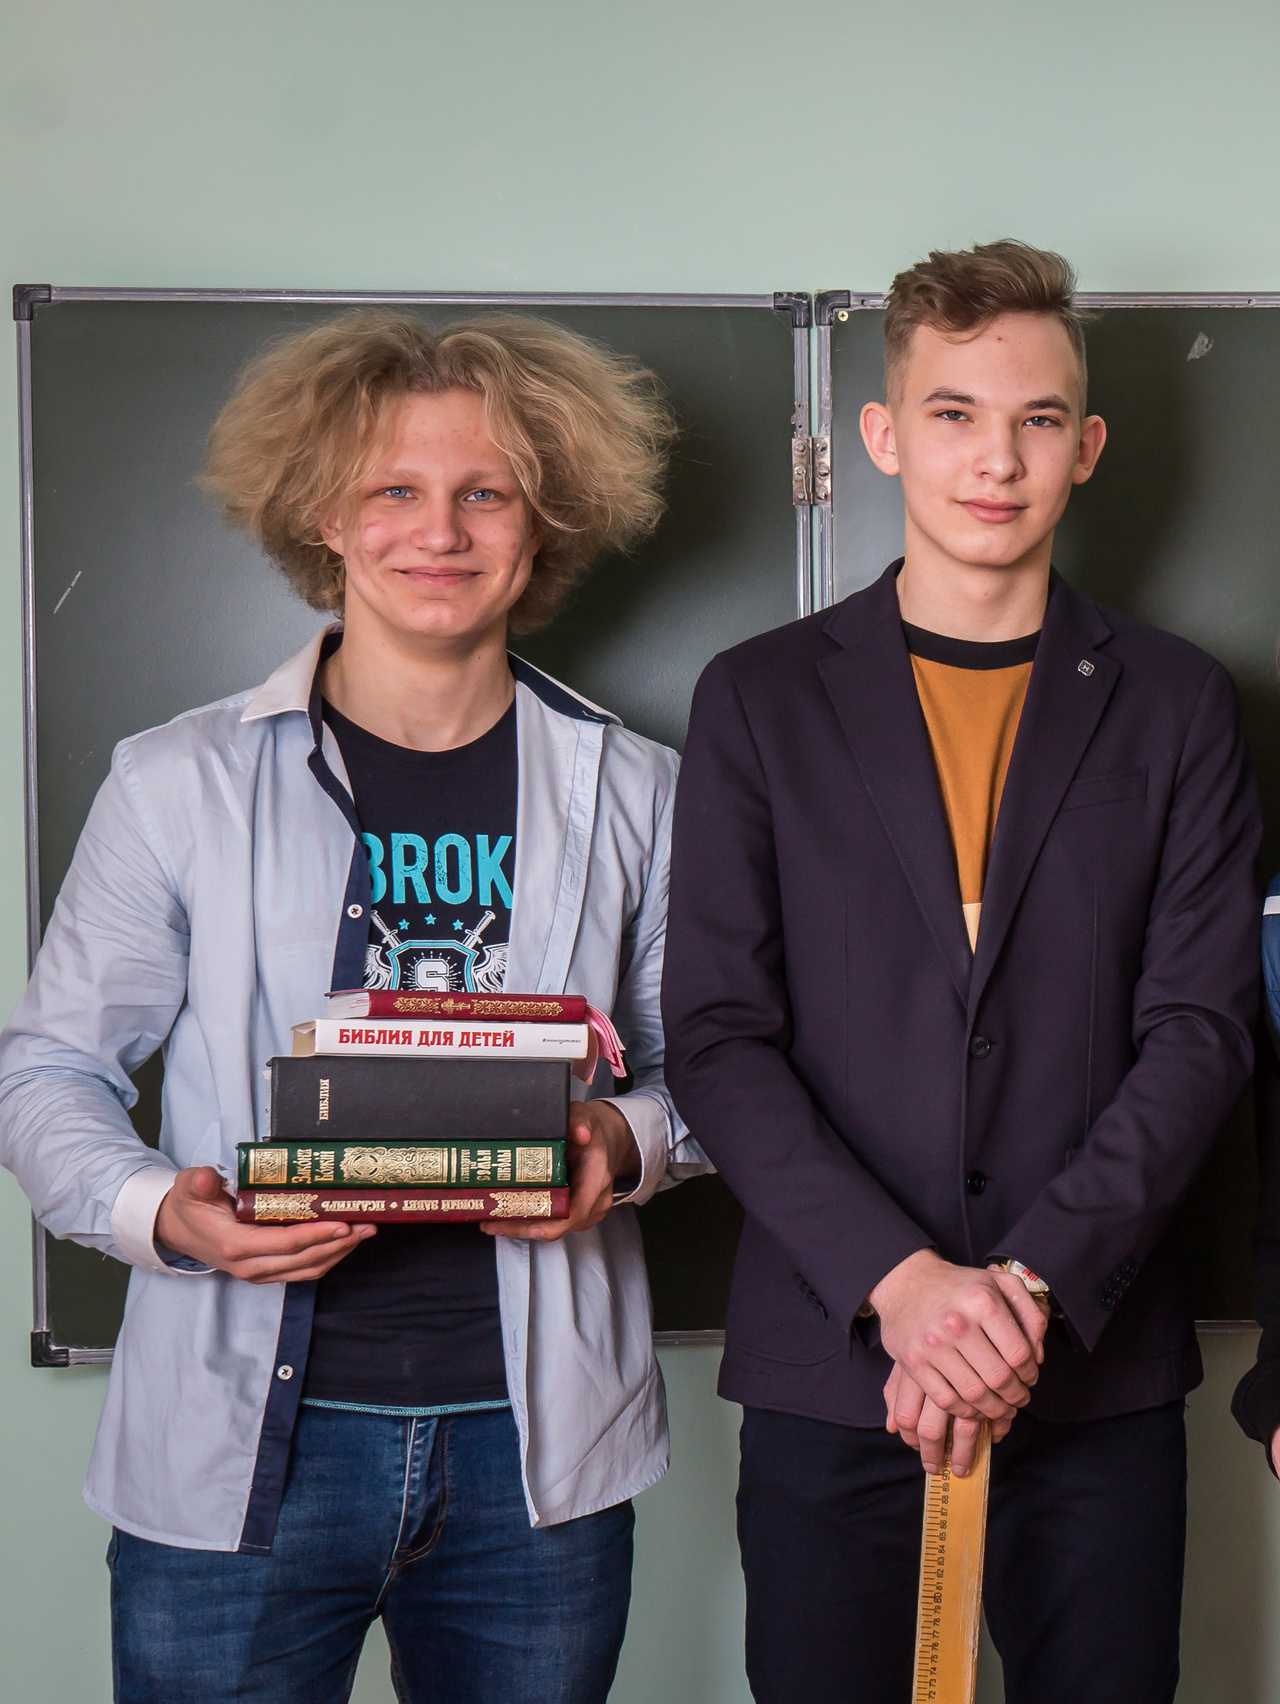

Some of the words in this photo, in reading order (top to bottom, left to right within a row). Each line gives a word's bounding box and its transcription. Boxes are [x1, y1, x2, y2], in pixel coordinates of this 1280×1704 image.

[338, 1028, 413, 1046] БИБЛИЯ
[417, 1030, 454, 1047] ДЛЯ
[458, 1030, 515, 1048] ДЕТЕЙ
[318, 1078, 330, 1121] БИБЛИЯ
[321, 1200, 386, 1212] ПСАЛТИРЬ
[402, 1199, 439, 1211] ЗАВЕТ
[441, 1199, 485, 1212] НОВЫЙ
[942, 1469, 950, 1481] 90
[942, 1482, 950, 1492] 89
[941, 1495, 949, 1504] 88
[940, 1507, 948, 1517] 87
[939, 1520, 947, 1529] 86
[939, 1531, 947, 1541] 85
[938, 1545, 946, 1554] 84
[937, 1556, 945, 1566] 83
[936, 1568, 944, 1578] 82
[936, 1581, 943, 1590] 81
[934, 1592, 942, 1603] 80
[934, 1605, 942, 1614] 79
[933, 1617, 941, 1627] 78
[932, 1629, 940, 1639] 77
[931, 1642, 939, 1651] 76
[930, 1654, 938, 1663] 75
[929, 1666, 937, 1676] 74
[929, 1678, 937, 1688] 73
[928, 1690, 936, 1699] 72
